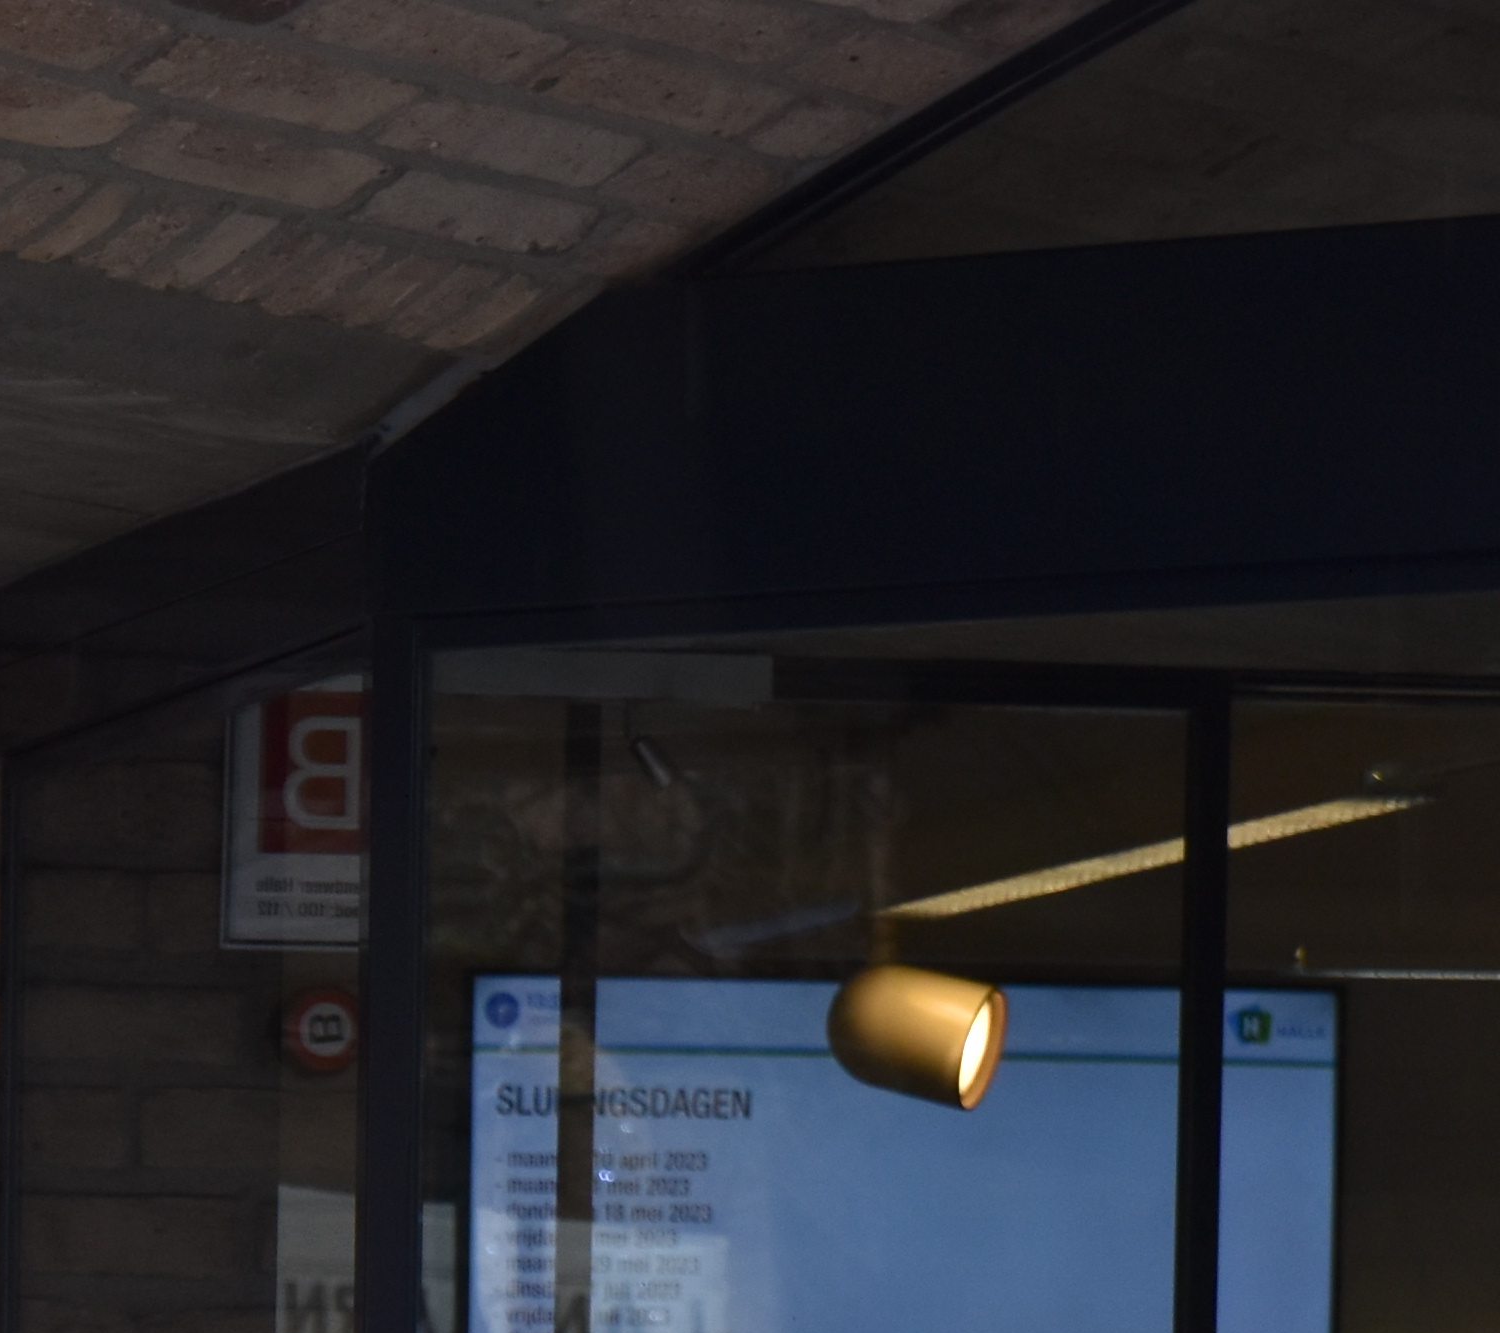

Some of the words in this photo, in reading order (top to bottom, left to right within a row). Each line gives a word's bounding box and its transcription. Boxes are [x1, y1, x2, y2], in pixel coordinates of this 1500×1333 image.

[664, 1151, 709, 1171] 2023
[646, 1177, 691, 1197] 2023
[668, 1203, 714, 1224] 2023
